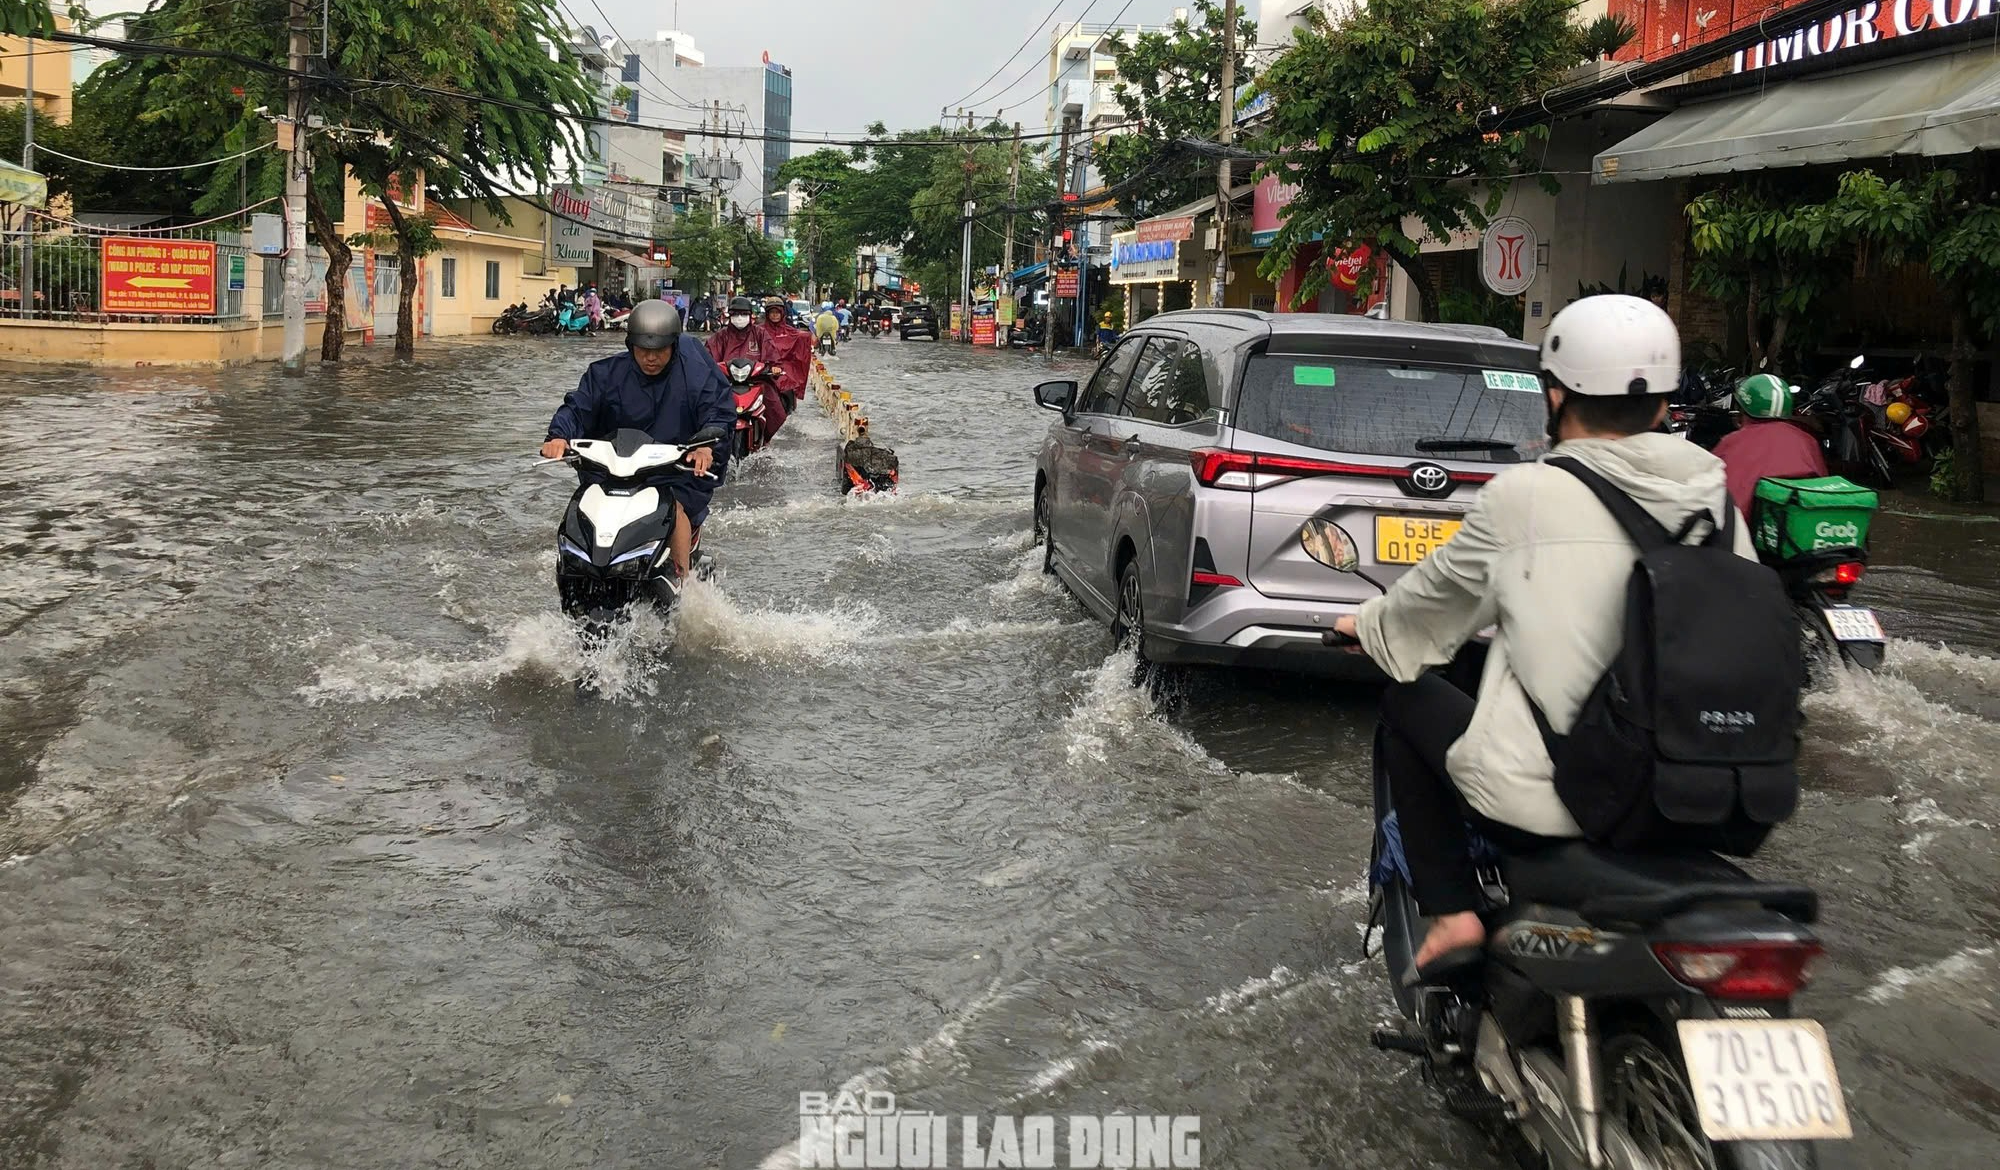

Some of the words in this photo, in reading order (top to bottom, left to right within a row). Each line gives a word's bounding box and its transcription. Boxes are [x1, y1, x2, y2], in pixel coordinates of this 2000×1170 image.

[1894, 0, 2000, 36] CO
[553, 188, 591, 221] Chay
[562, 222, 580, 236] An
[108, 244, 126, 256] CÔNG
[127, 246, 136, 256] AN
[137, 246, 161, 258] PHƯỜNG
[172, 246, 188, 261] QUẬN
[189, 246, 198, 260] GÒ
[199, 247, 210, 260] VẤP
[554, 244, 590, 262] Khang
[135, 262, 156, 273] POLICE
[1404, 520, 1442, 540] 63E
[1815, 520, 1859, 538] Grab
